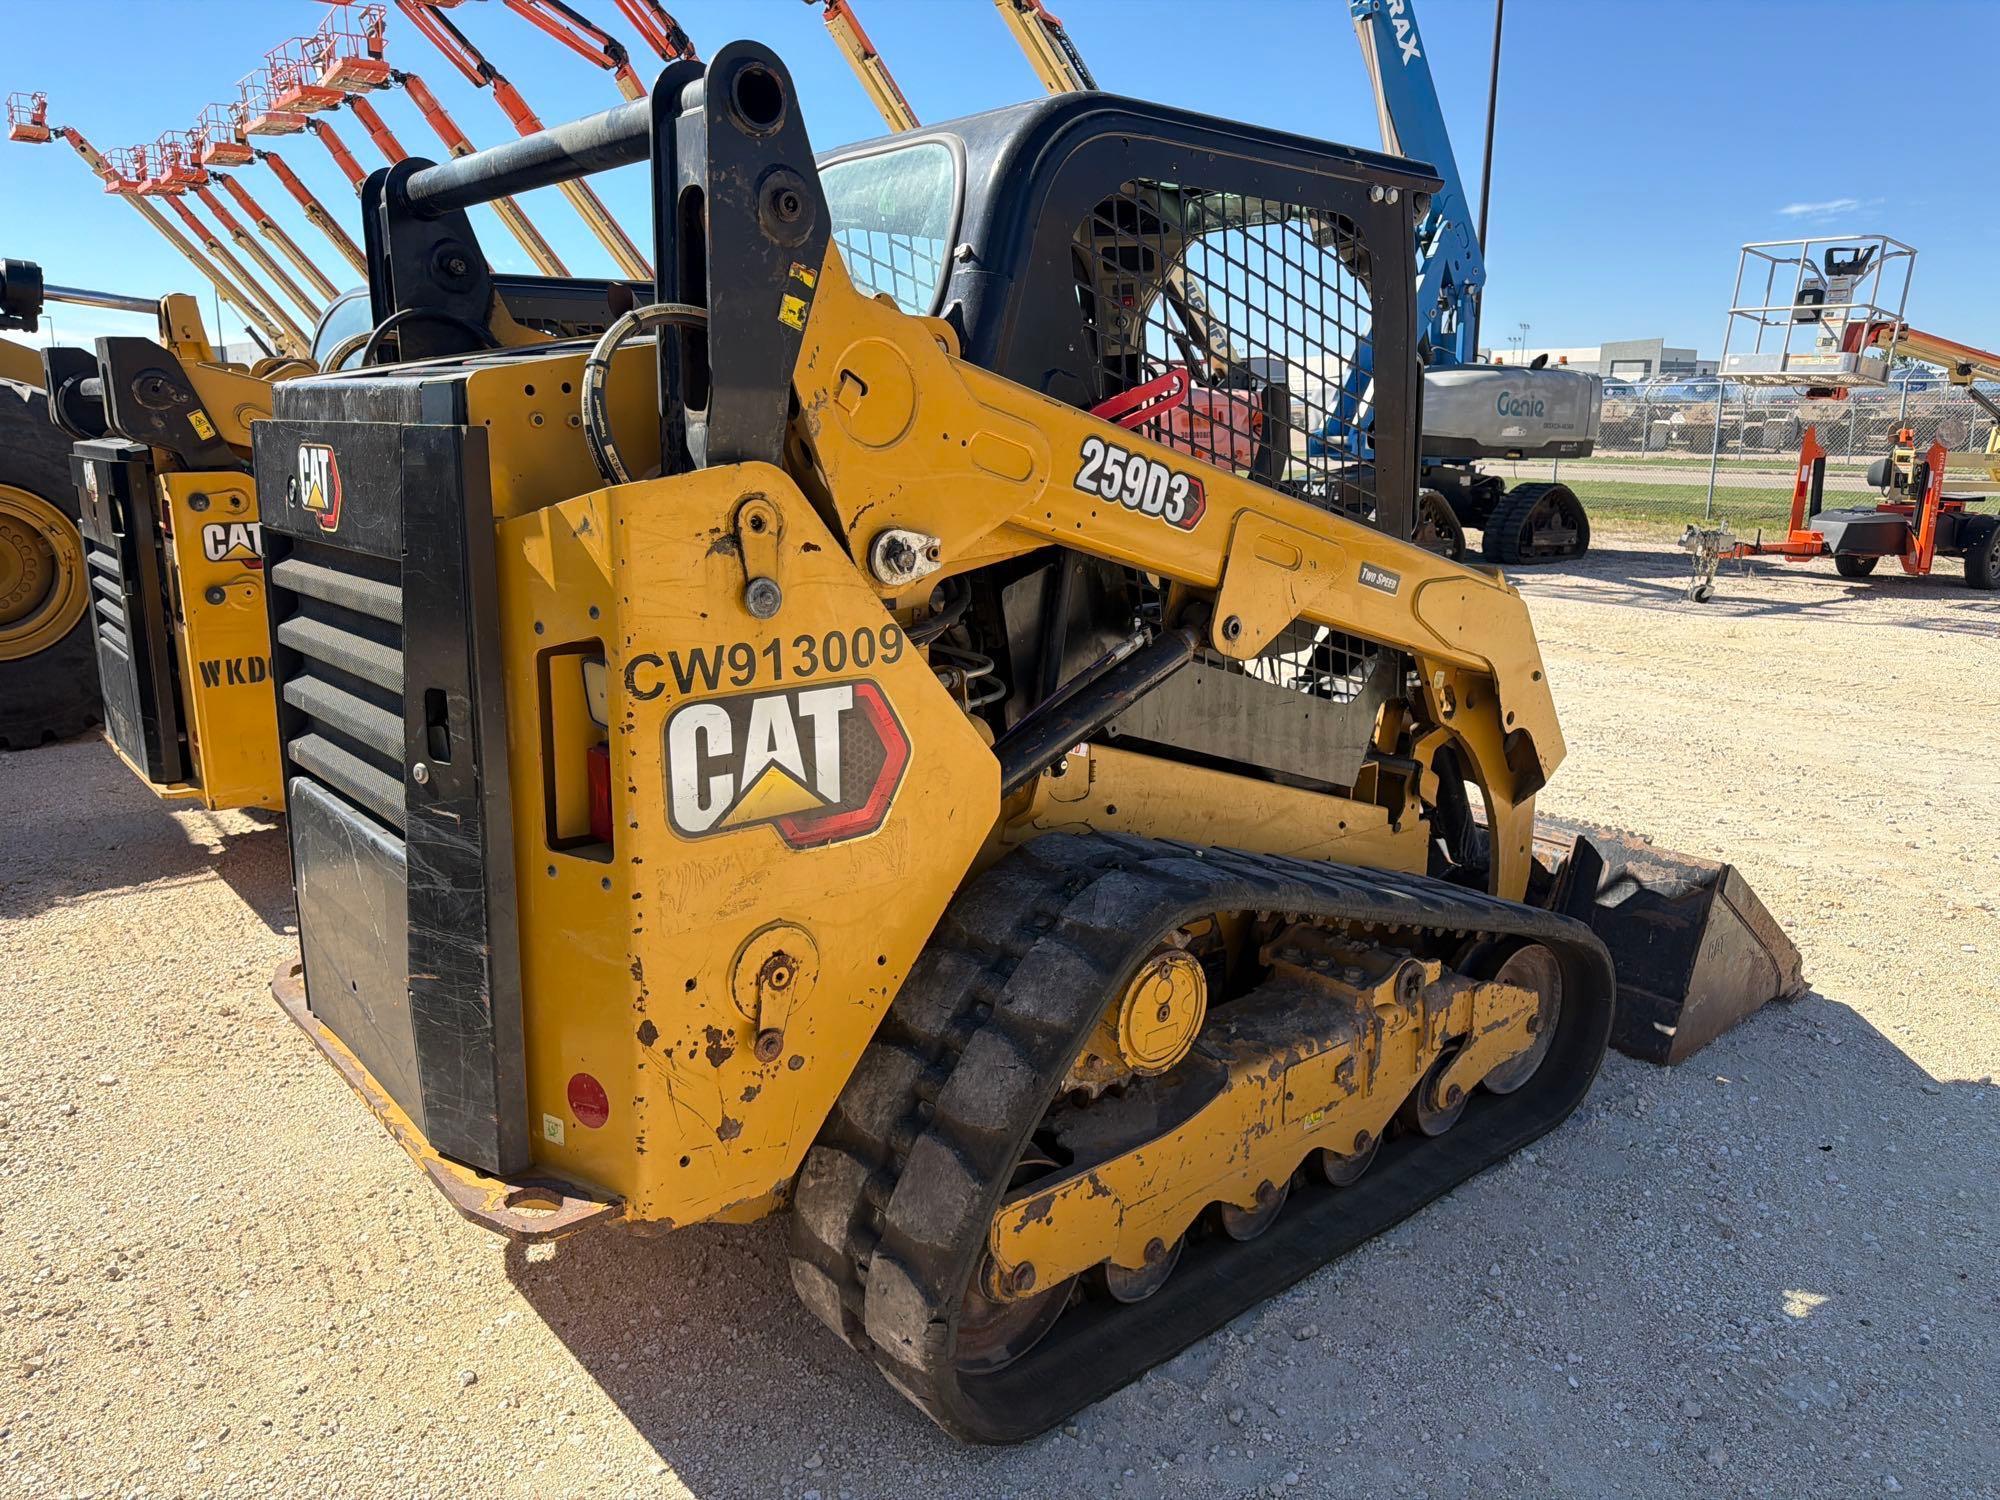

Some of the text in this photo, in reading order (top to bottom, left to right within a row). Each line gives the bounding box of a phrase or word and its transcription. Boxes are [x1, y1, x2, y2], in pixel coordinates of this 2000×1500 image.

[1497, 391, 1545, 418] Genie
[300, 447, 329, 509] CAT
[1076, 438, 1190, 522] 259D3
[199, 656, 273, 688] WKD
[624, 623, 904, 701] CW913009
[669, 685, 853, 832] CAT
